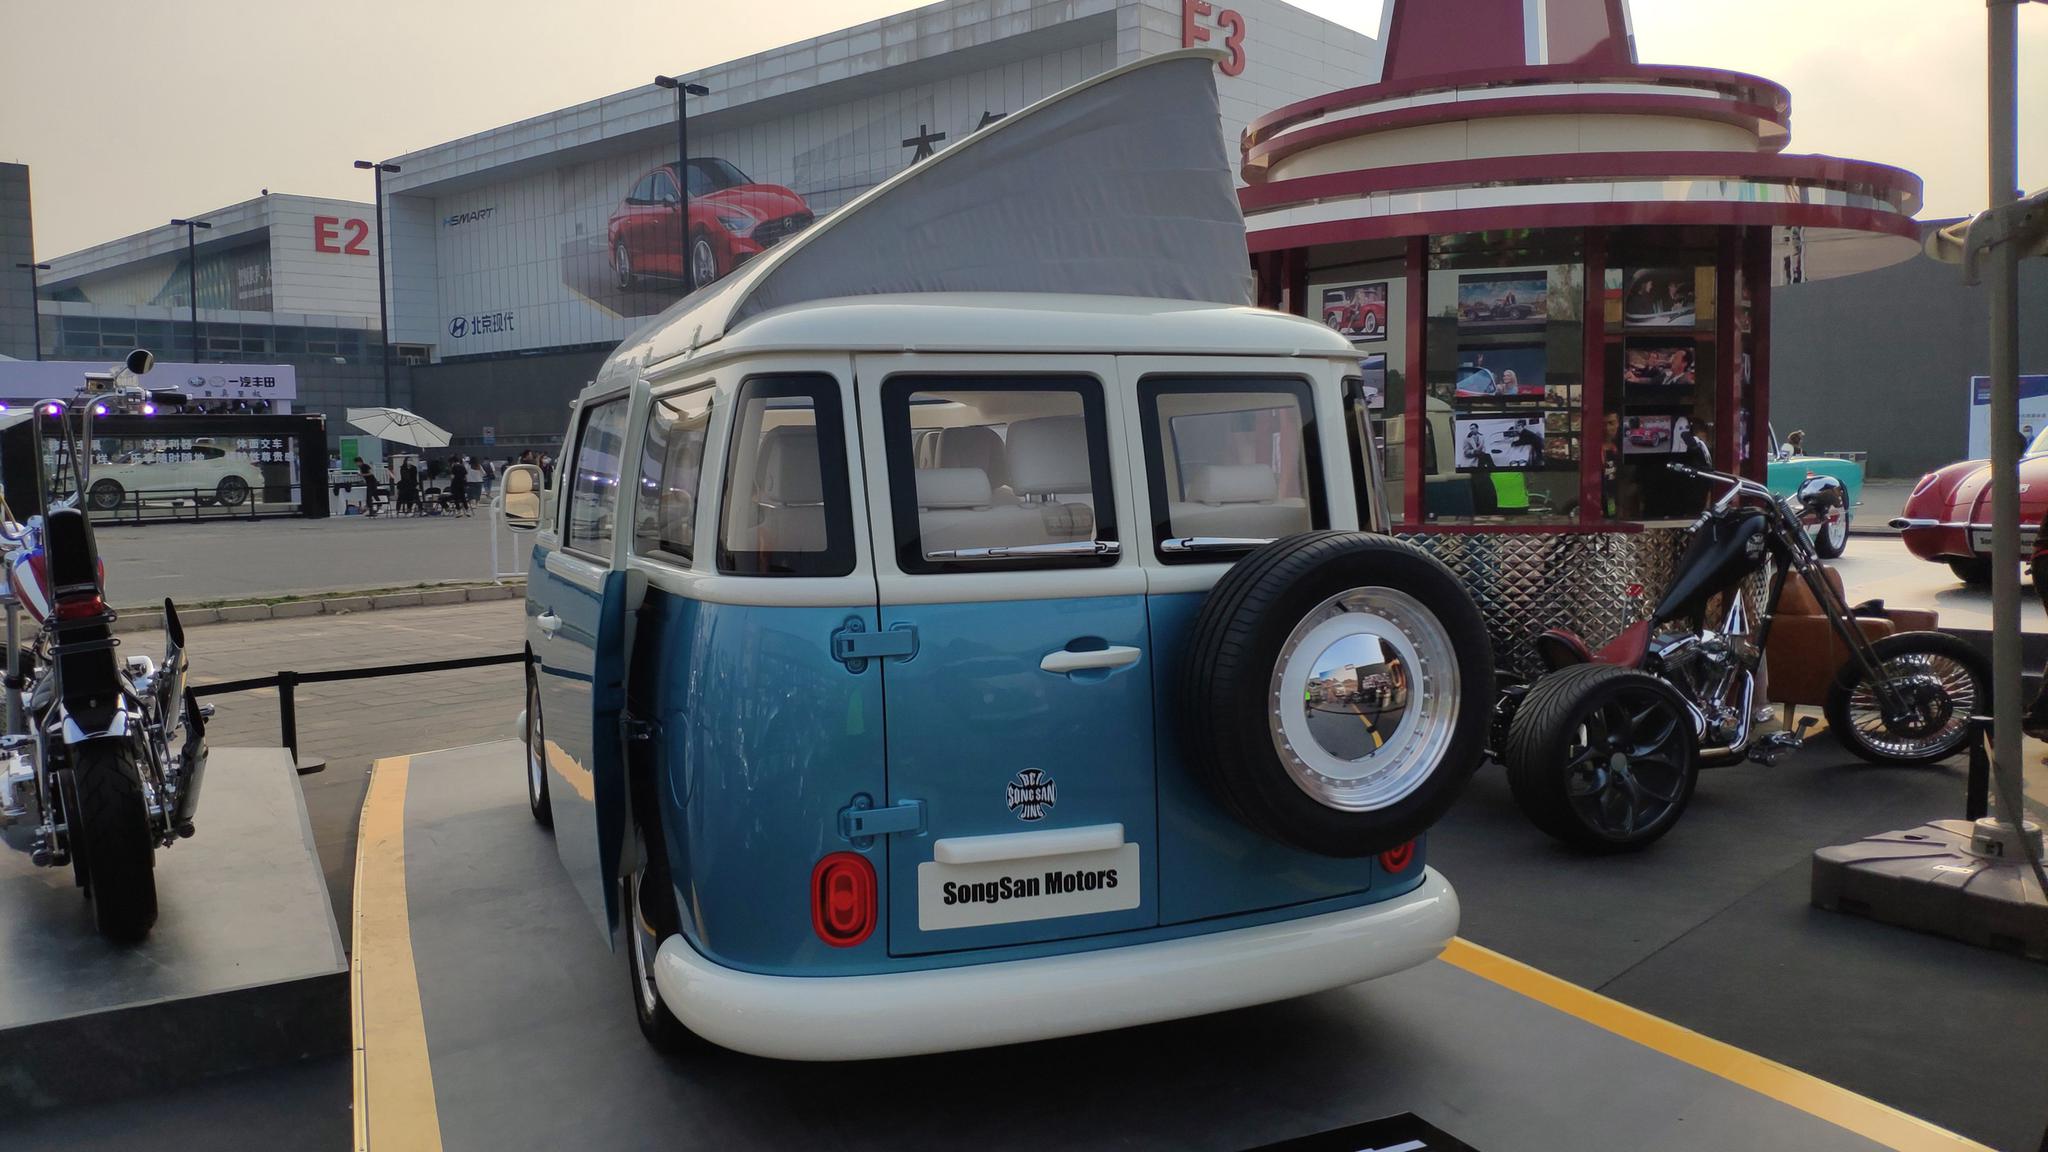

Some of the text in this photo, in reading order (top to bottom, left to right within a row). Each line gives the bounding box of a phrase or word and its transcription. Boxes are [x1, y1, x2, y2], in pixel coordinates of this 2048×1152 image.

[314, 216, 370, 256] E2
[471, 312, 514, 335] 北京现代
[228, 376, 275, 388] 一汽丰田
[943, 868, 1118, 906] SongSan Motors
